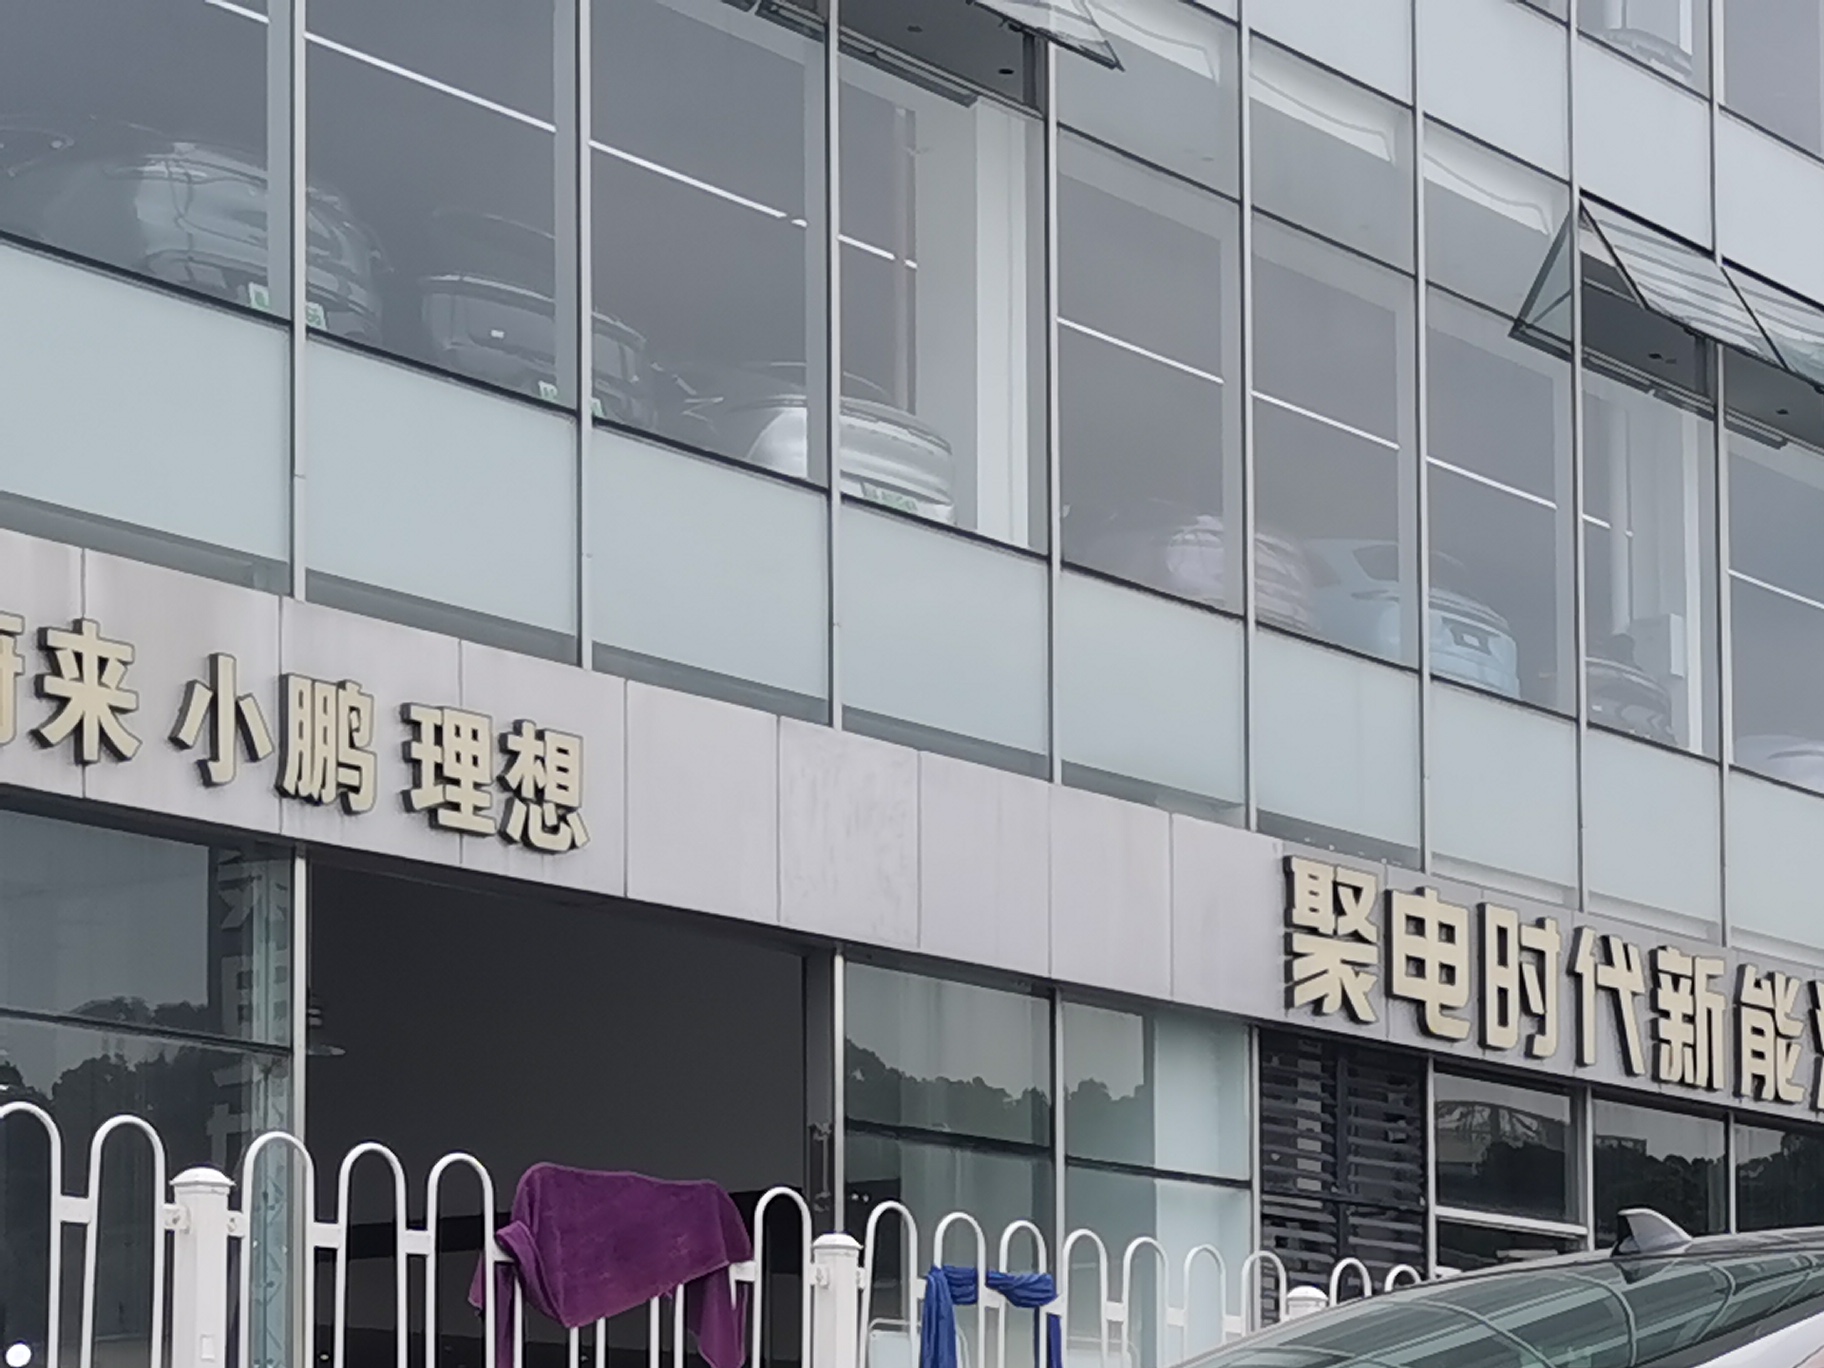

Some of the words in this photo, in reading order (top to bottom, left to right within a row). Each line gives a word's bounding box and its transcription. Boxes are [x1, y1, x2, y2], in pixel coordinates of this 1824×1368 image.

[0, 604, 142, 766] 来
[169, 652, 377, 814] 小鹏
[401, 701, 591, 854] 理想
